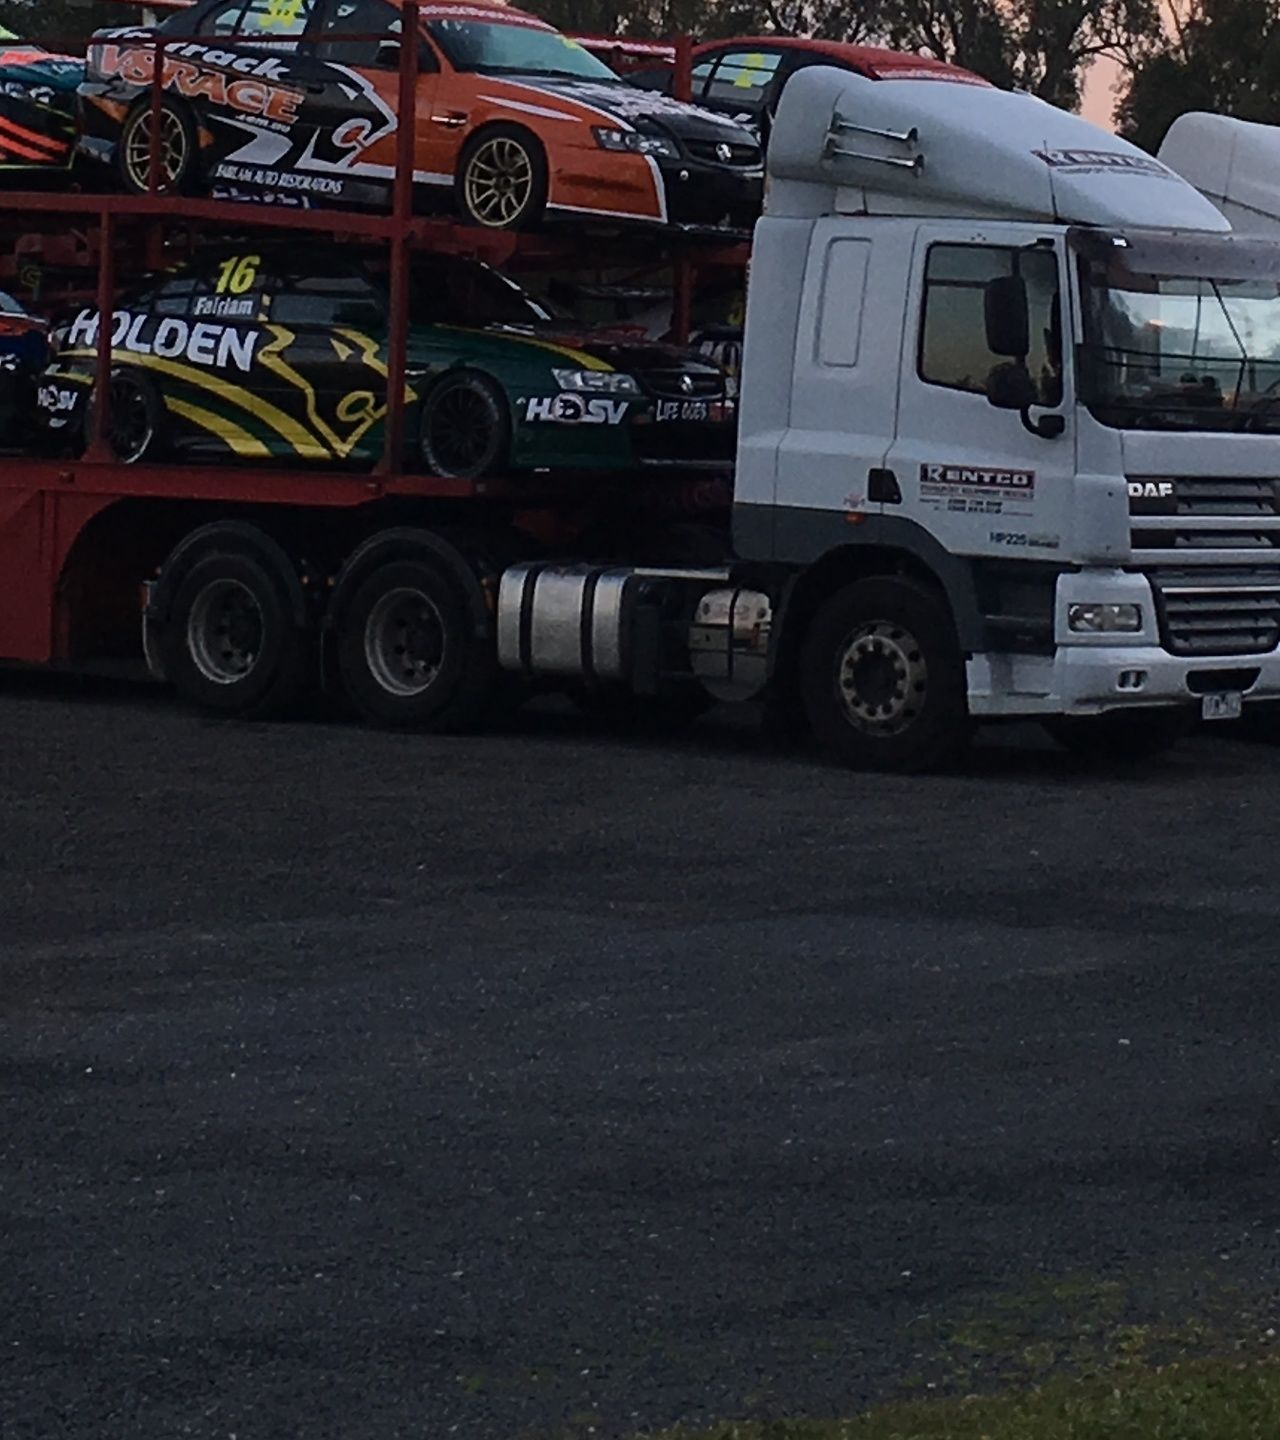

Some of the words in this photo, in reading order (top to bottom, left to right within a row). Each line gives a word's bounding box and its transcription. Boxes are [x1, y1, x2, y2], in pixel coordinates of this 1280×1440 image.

[107, 26, 290, 81] farack
[100, 43, 306, 124] V8RACE
[213, 253, 261, 295] 16
[68, 307, 259, 373] HOLDEN
[926, 464, 1029, 486] RENTCO
[1128, 482, 1173, 498] DAF
